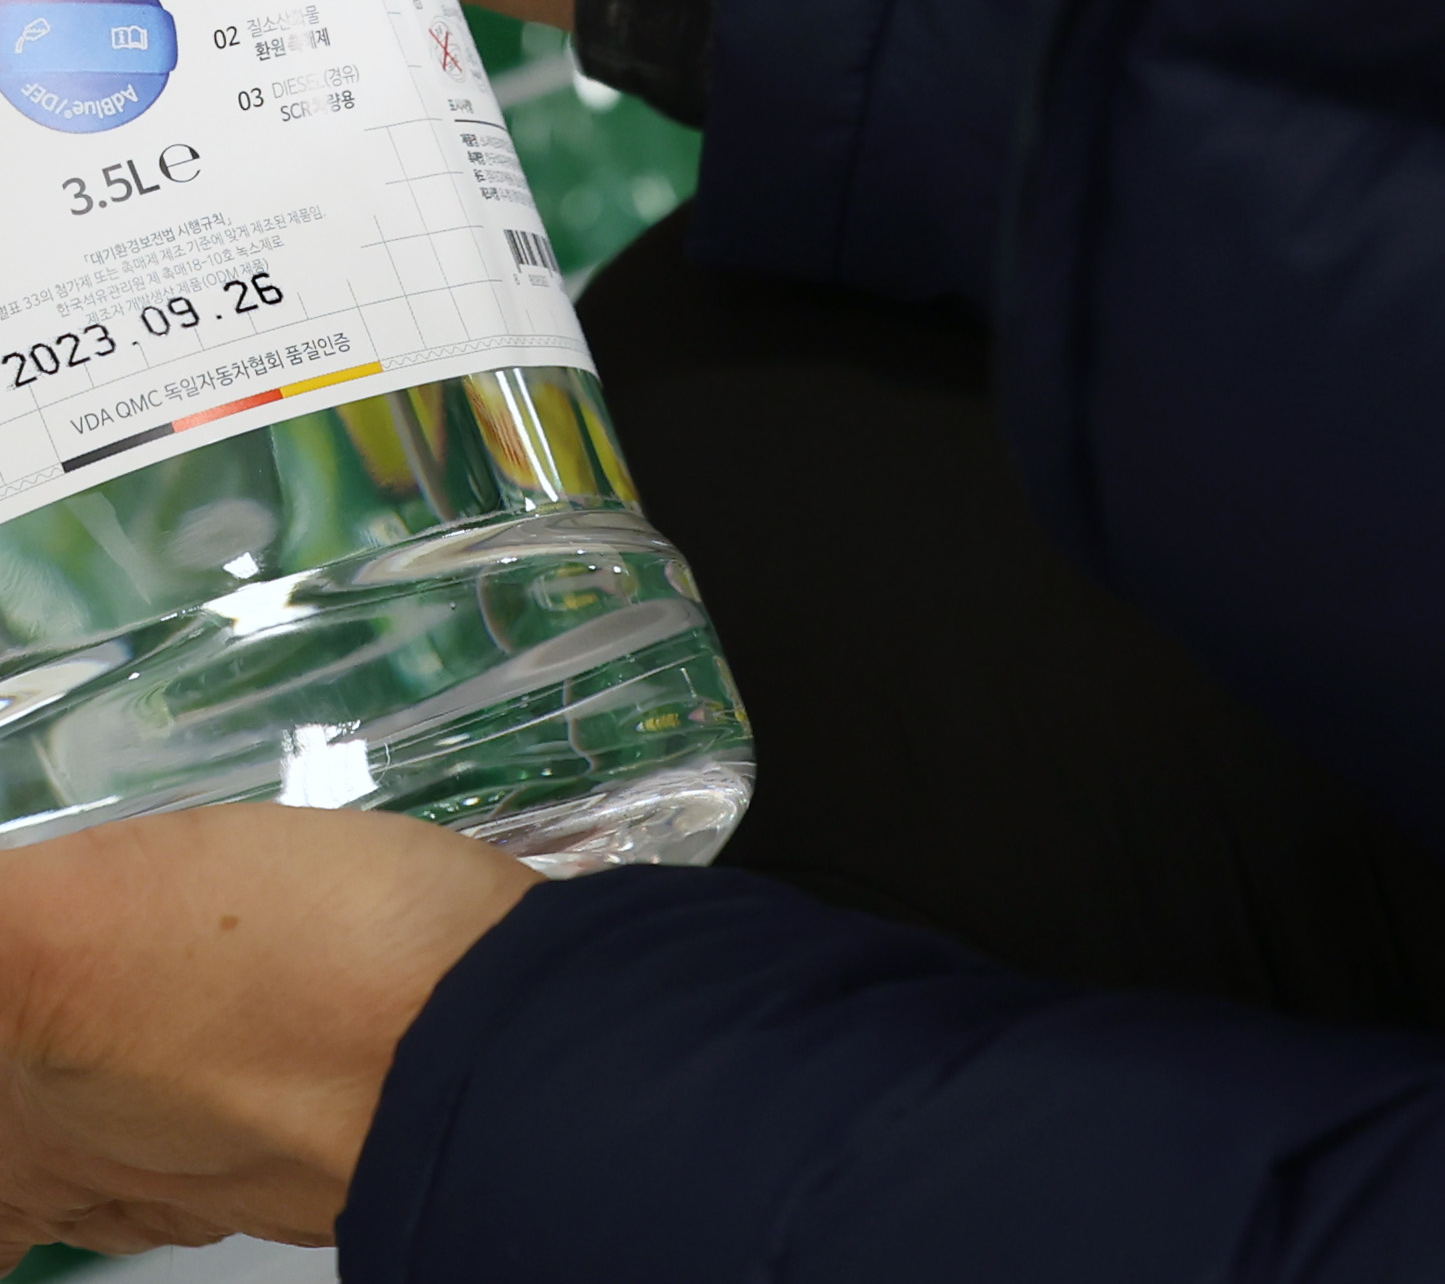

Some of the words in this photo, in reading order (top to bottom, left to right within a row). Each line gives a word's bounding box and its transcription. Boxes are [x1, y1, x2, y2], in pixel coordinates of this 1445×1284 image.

[213, 26, 240, 50] 02
[254, 37, 287, 62] 환원
[237, 87, 265, 111] 03
[23, 288, 54, 311] 33의
[55, 273, 93, 299] 첨가제
[93, 266, 120, 285] 또는
[161, 245, 187, 263] 제조
[188, 233, 225, 253] 기준에
[252, 213, 287, 234] 제조된
[55, 276, 146, 319] 한국석유관리원
[235, 235, 286, 257] 녹스제로
[70, 407, 116, 435] VDA
[114, 389, 165, 420] QMC
[163, 349, 285, 402] 독일자동차협회
[284, 332, 351, 369] 품질인증
